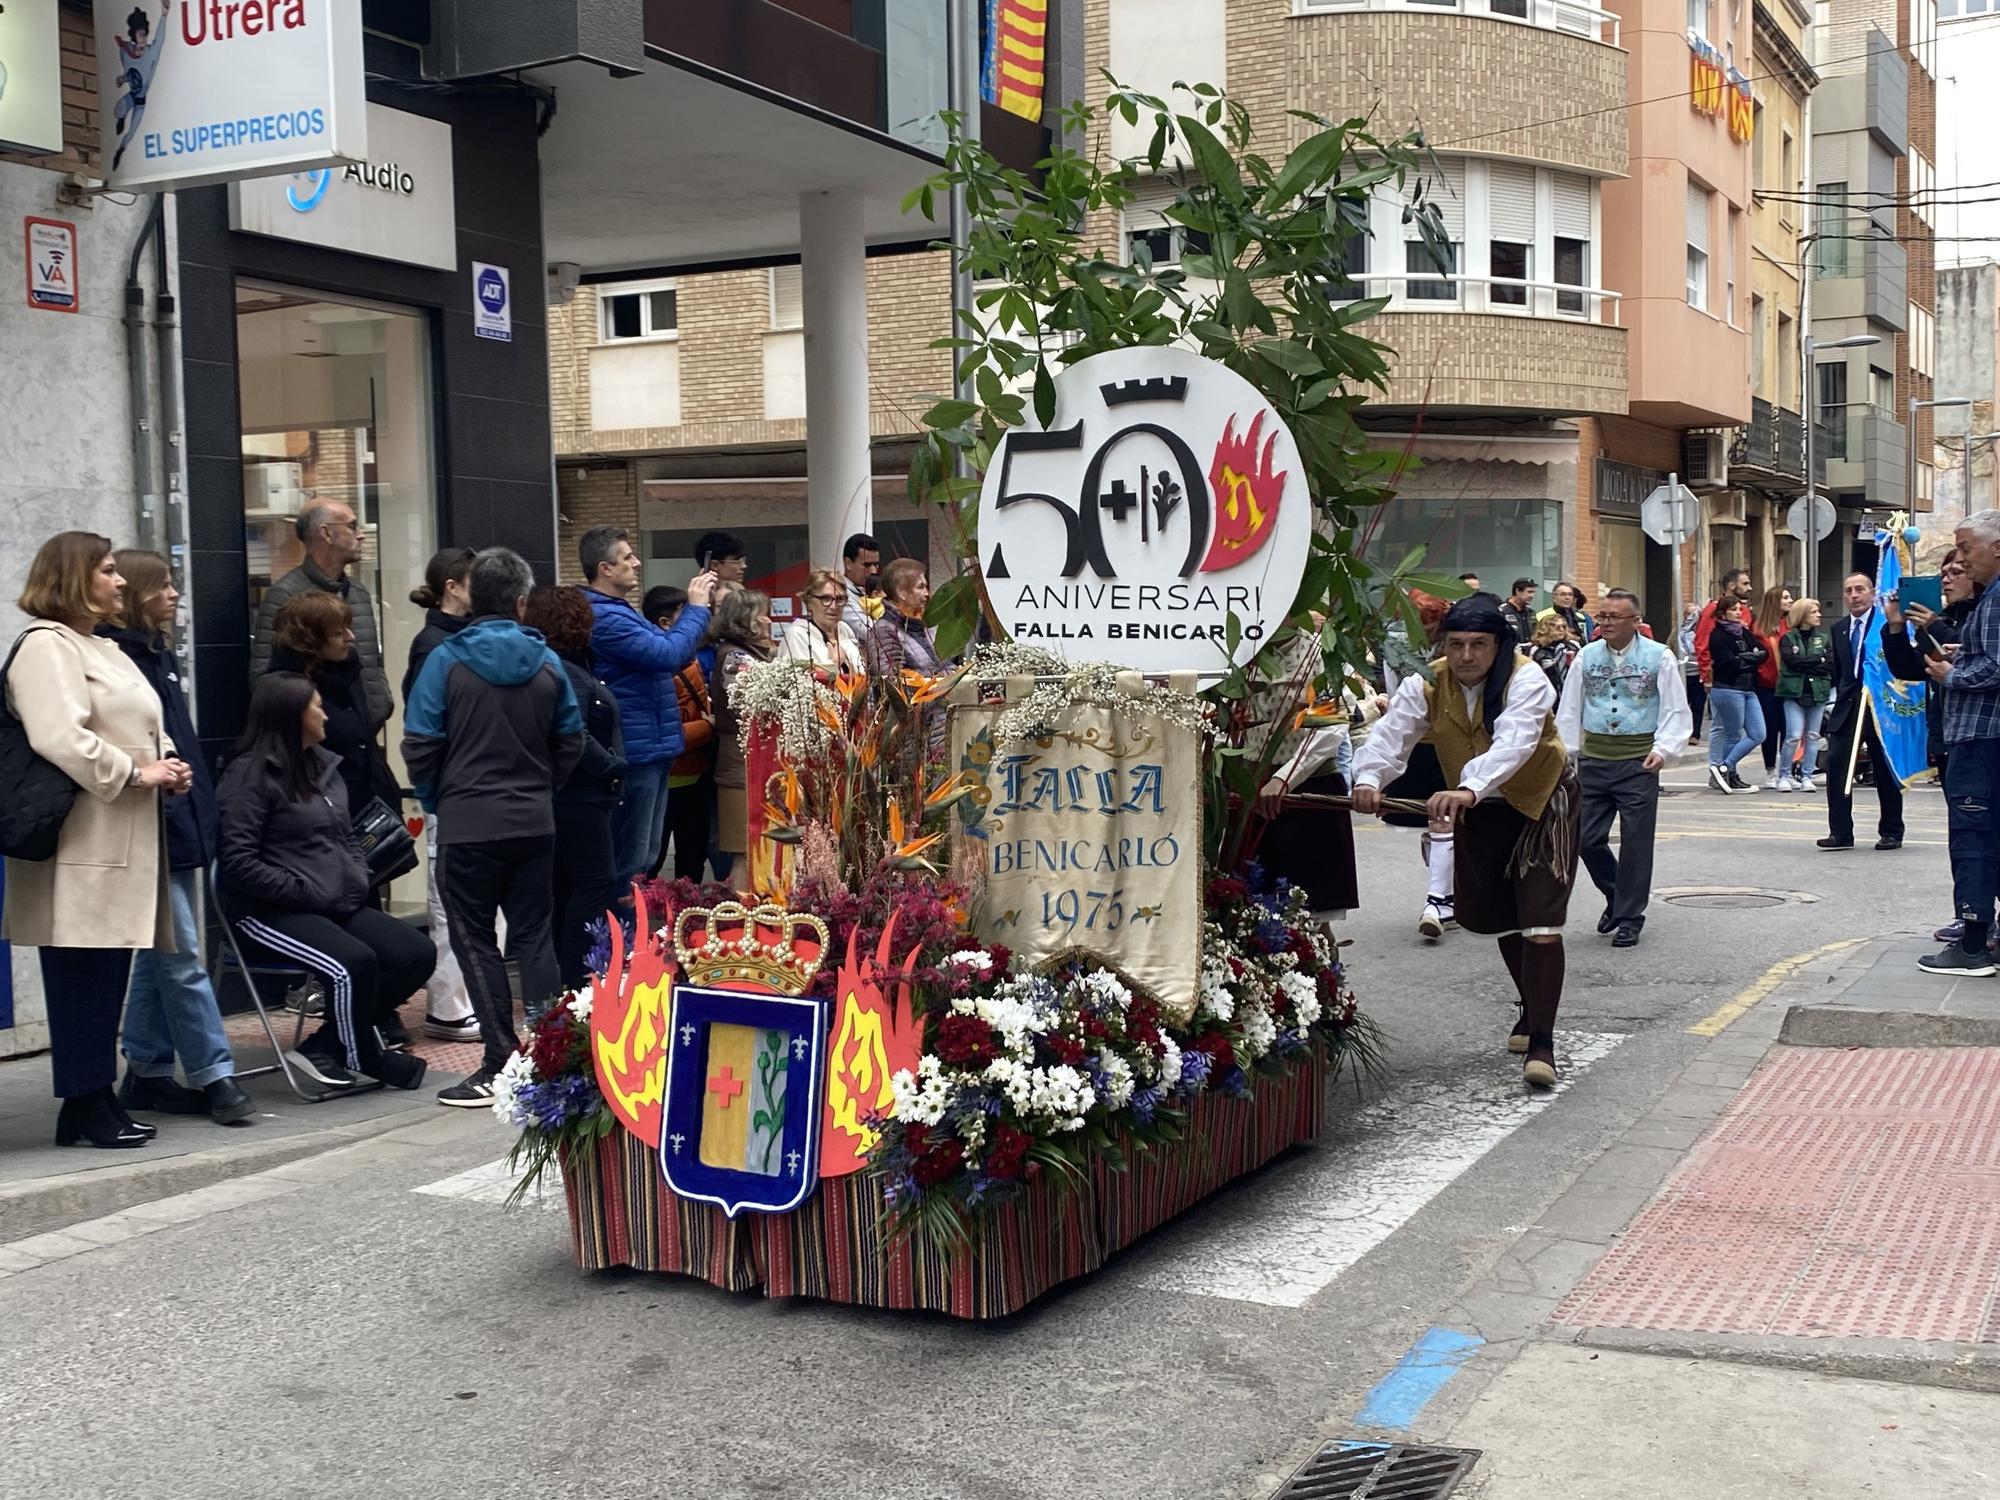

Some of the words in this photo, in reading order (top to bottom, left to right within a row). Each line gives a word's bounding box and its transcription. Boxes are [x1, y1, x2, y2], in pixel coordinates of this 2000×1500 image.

[181, 0, 306, 46] Utrera
[144, 134, 167, 158] EL
[172, 108, 325, 154] SUPERPRECIOS
[343, 163, 414, 195] Audio
[482, 283, 502, 300] ADT
[986, 418, 1209, 577] 50
[1015, 584, 1261, 612] ANIVERSARI
[1014, 623, 1094, 639] FALLA
[1107, 620, 1264, 640] BENICARÓ
[993, 832, 1180, 874] BENICARLÓ
[1041, 888, 1124, 937] 1975
